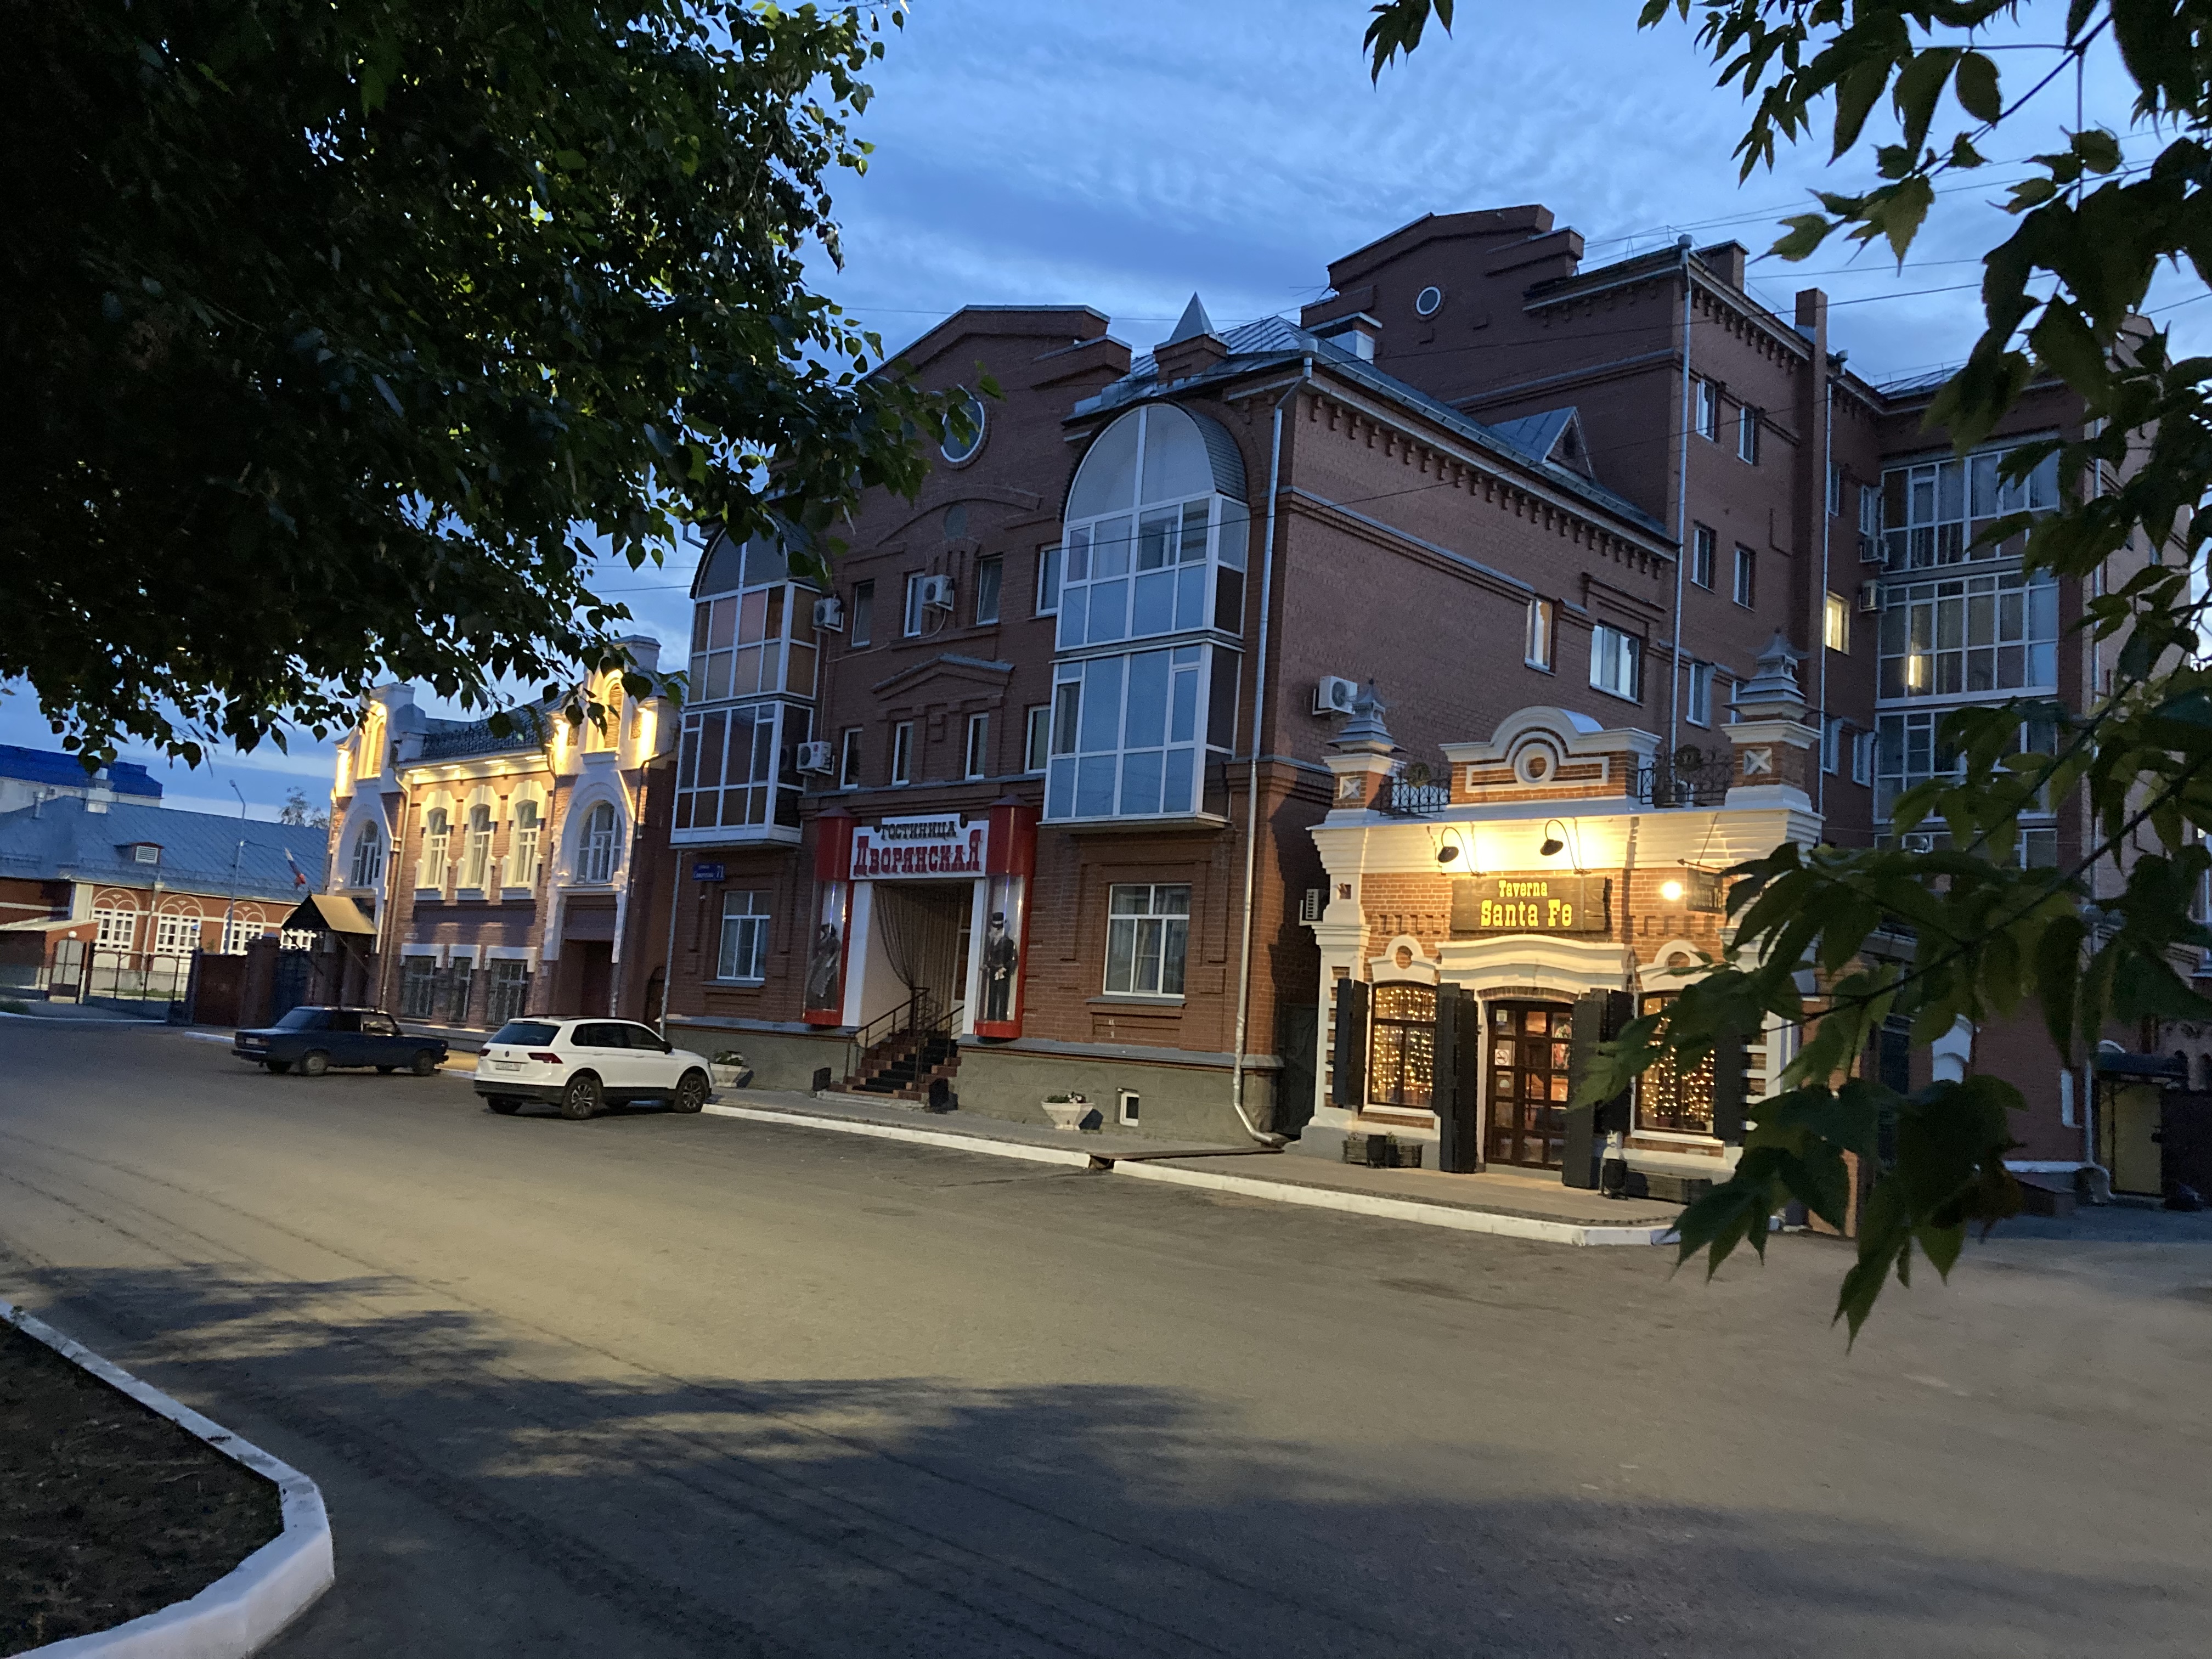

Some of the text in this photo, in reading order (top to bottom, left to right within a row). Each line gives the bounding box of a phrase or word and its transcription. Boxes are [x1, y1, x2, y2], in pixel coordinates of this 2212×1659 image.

[881, 821, 957, 840] ГОСТИНИЦА
[854, 829, 981, 877] ДВОРЯНСКАЯ
[1498, 880, 1548, 898] Taverna
[1481, 899, 1572, 927] Santa Fe
